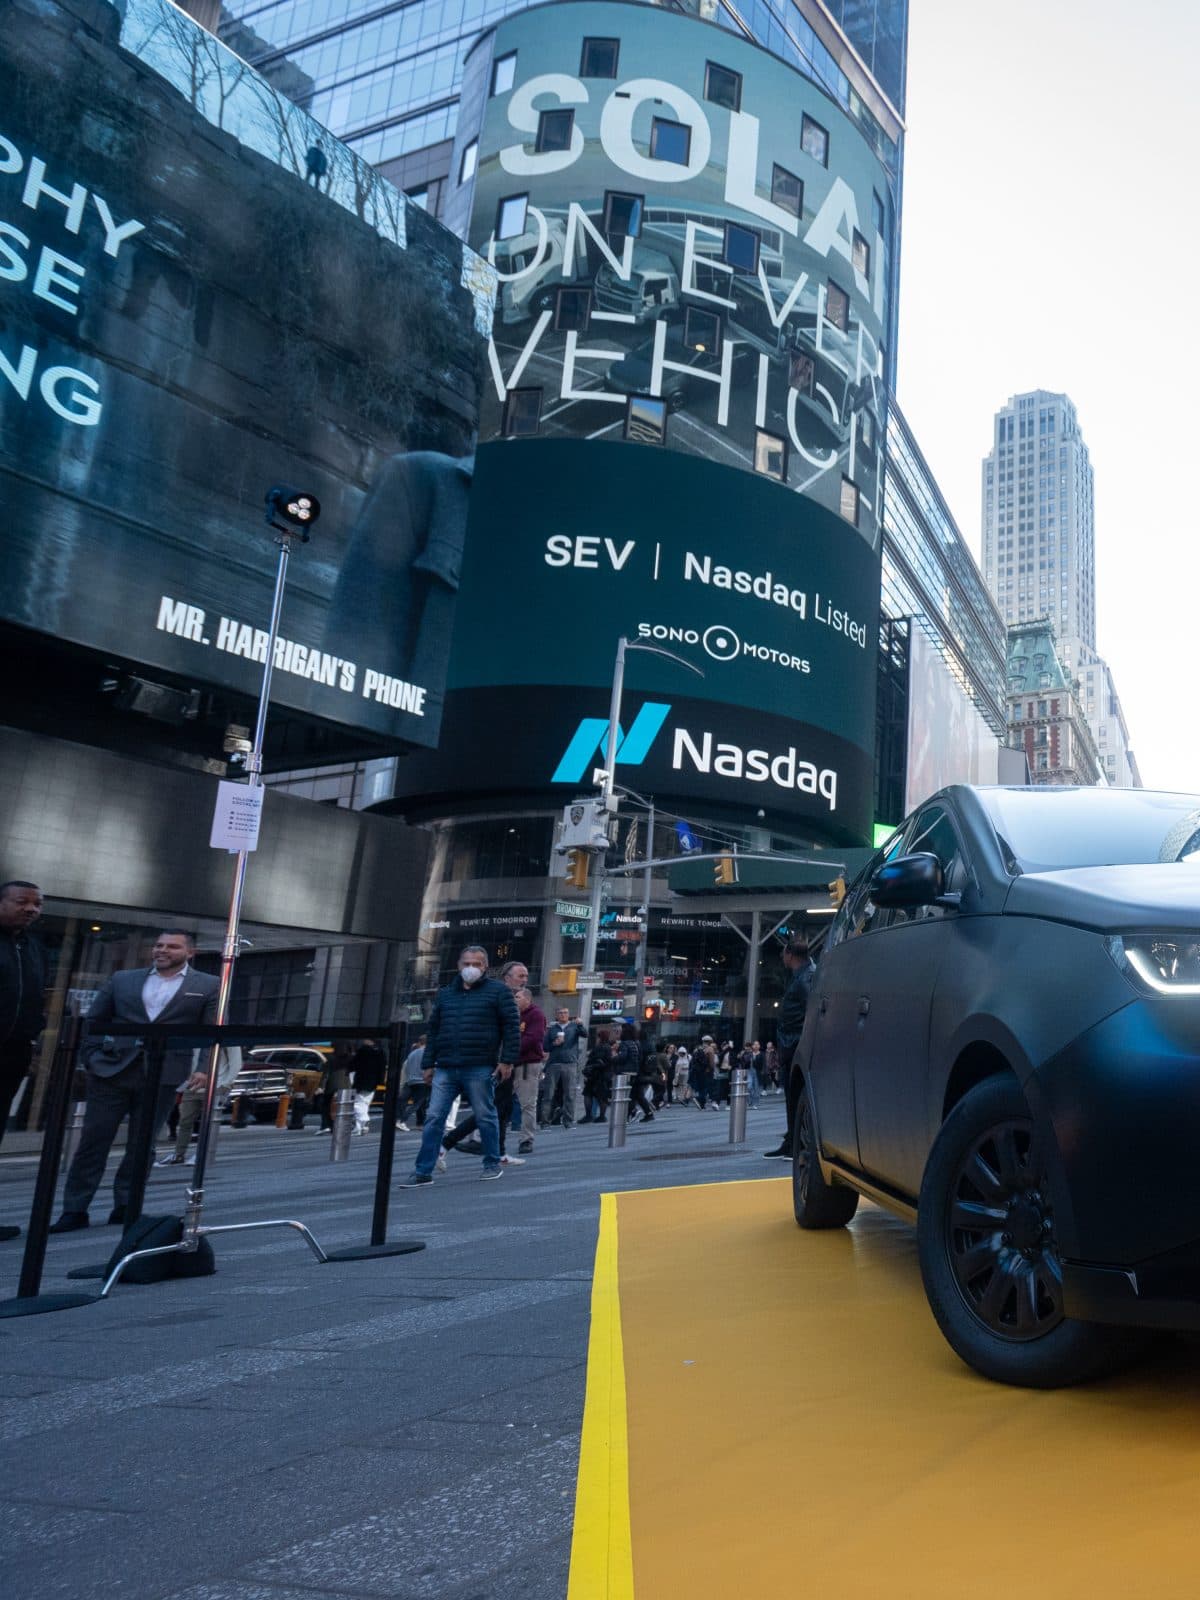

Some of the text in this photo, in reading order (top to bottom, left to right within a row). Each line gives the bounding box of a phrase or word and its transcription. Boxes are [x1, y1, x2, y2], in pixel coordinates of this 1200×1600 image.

[544, 534, 867, 649] SEV Nasdaq Listed
[156, 595, 428, 717] MR. HARRIGAN'S PHONE
[638, 622, 811, 674] SONO MOTORS
[671, 728, 838, 811] Nasdaq
[493, 916, 537, 925] TOMORROW
[556, 902, 588, 917] BROADWAY
[616, 914, 642, 924] Nasda
[661, 917, 695, 927] REWRITE
